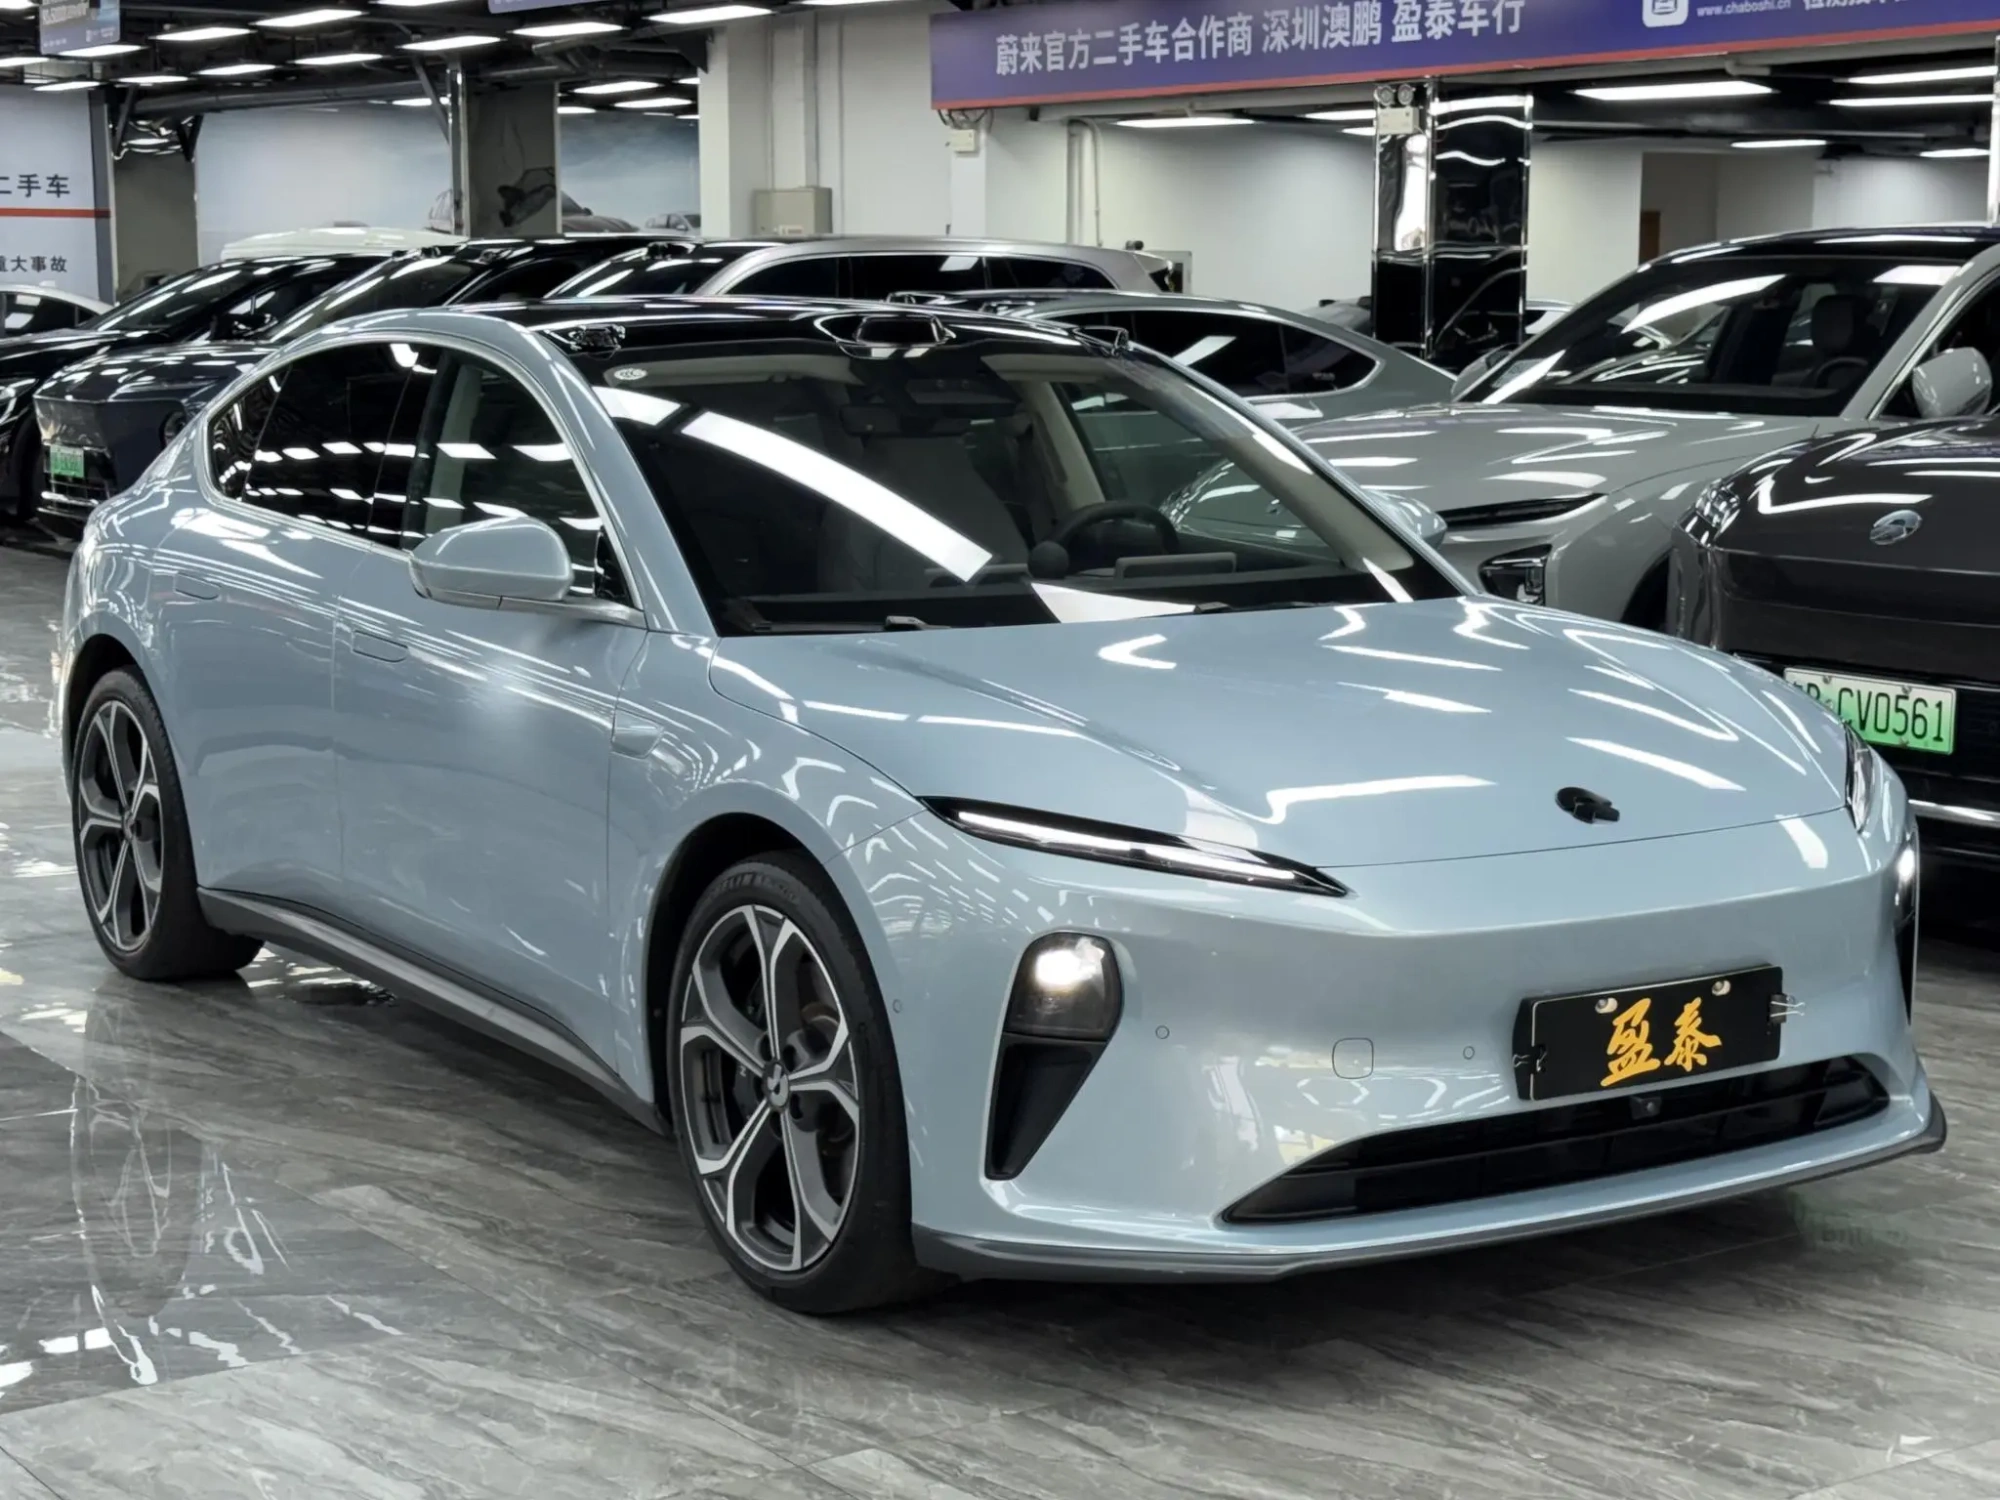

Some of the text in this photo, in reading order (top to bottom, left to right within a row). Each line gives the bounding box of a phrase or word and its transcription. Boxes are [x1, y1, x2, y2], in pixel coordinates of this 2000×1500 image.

[996, 0, 1525, 75] 蔚来官方二手车合作商 深圳澳鹏 盈泰车行
[1600, 997, 1722, 1087] 盈泰
